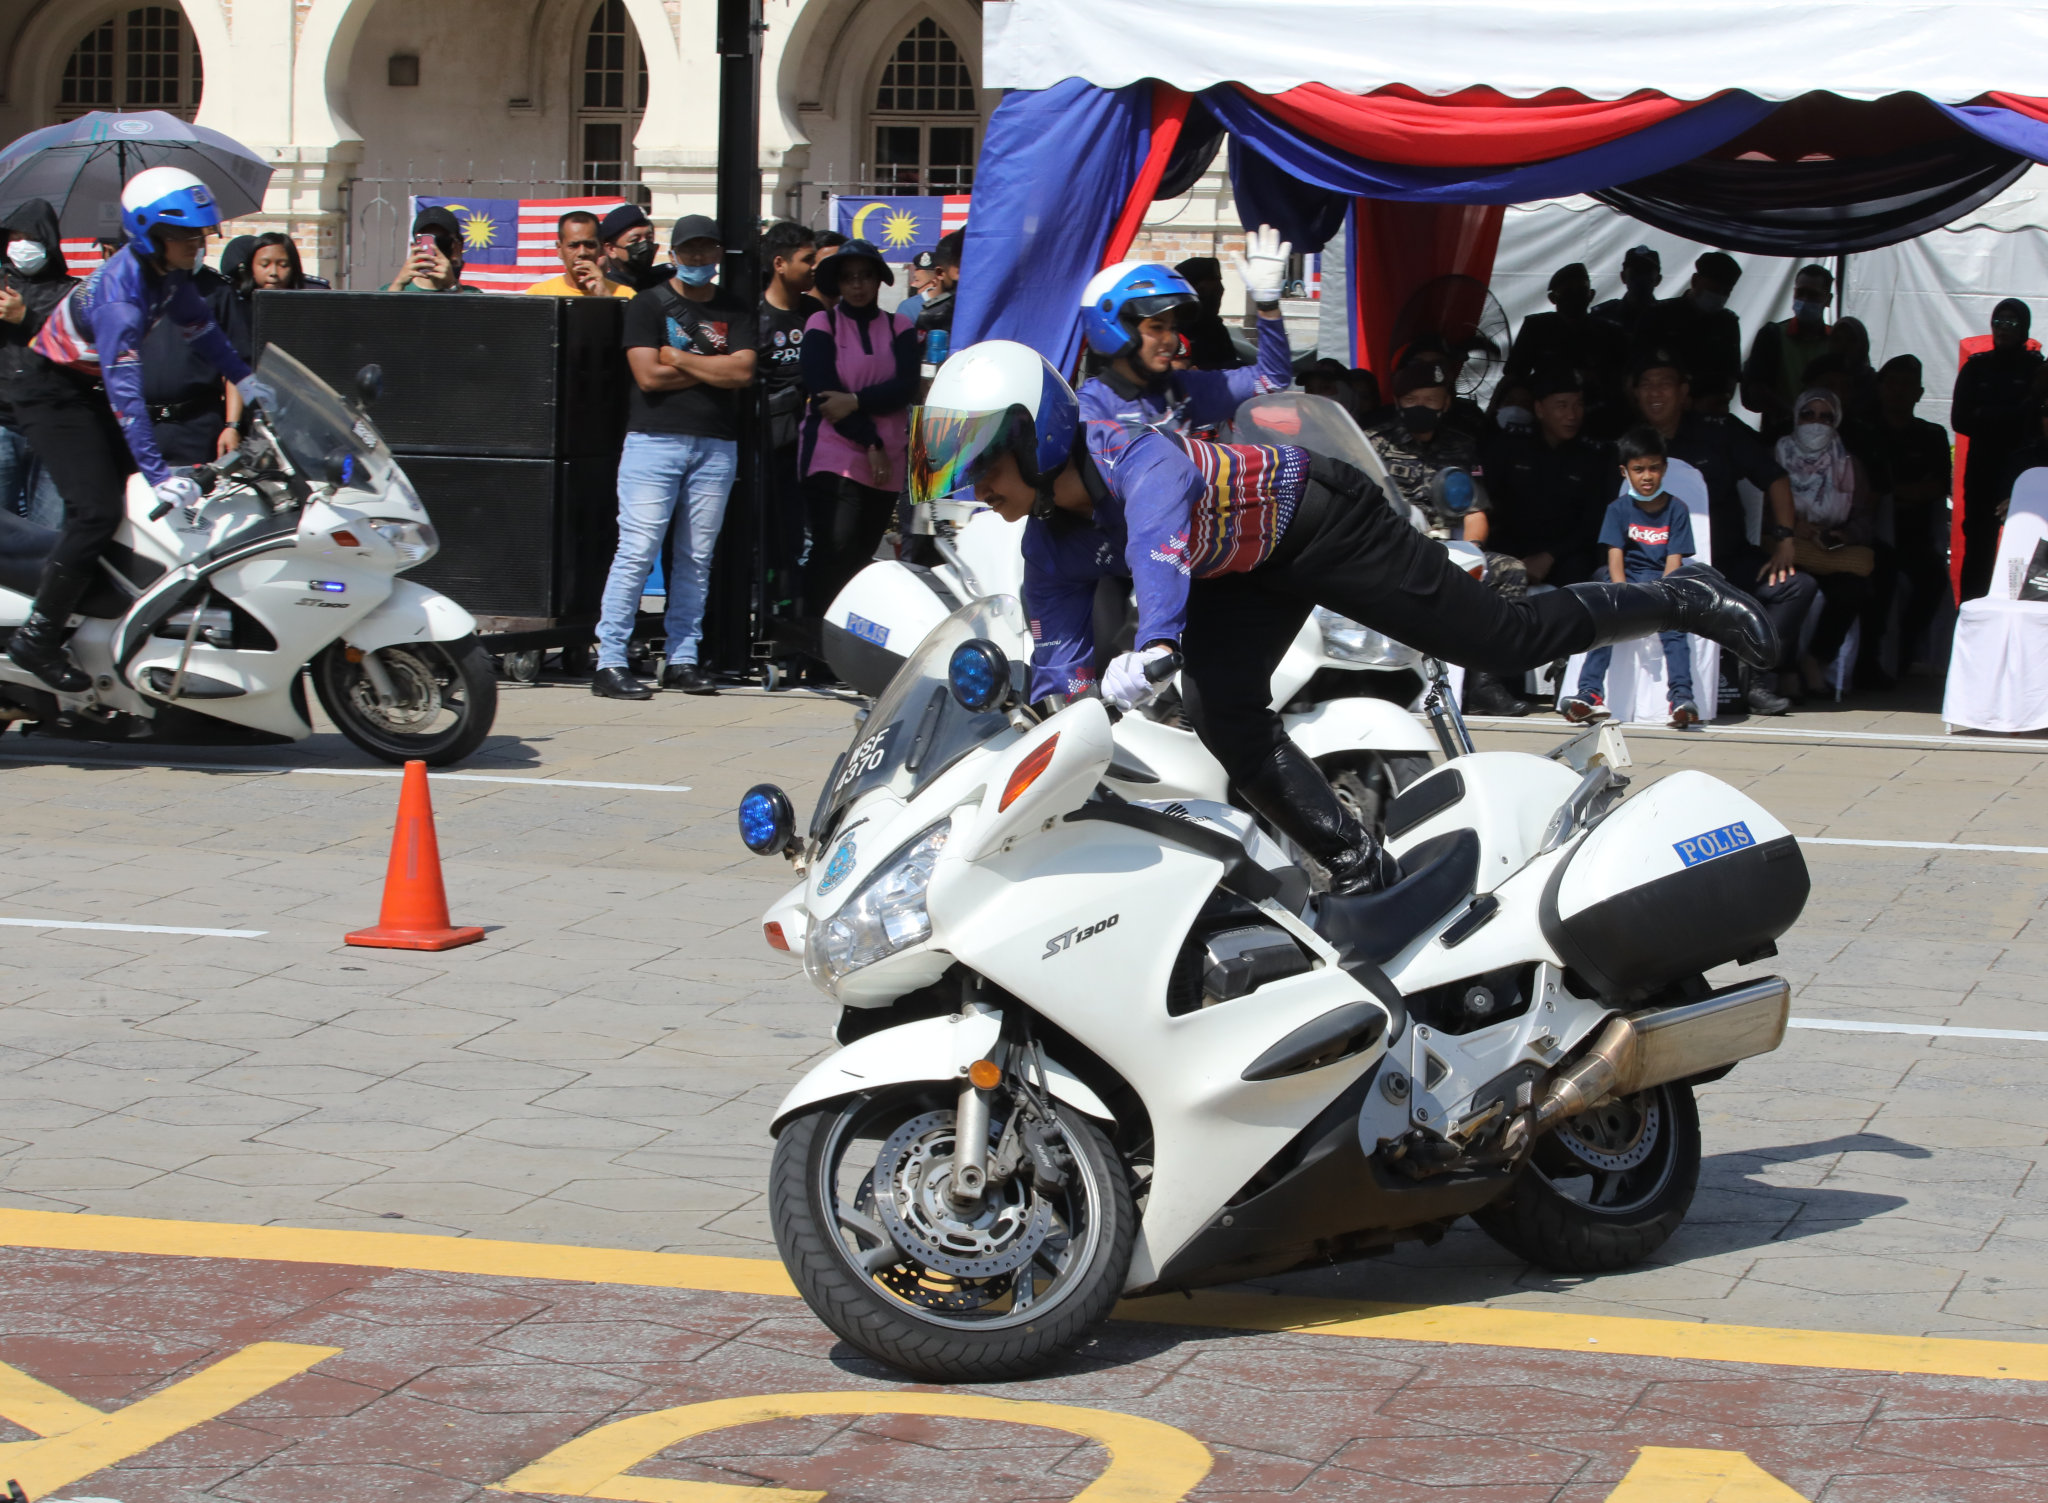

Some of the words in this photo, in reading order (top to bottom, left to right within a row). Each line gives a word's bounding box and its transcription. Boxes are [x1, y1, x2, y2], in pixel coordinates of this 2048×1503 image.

[847, 614, 887, 644] POLIS
[848, 727, 890, 767] WSF
[834, 748, 885, 794] 4370
[1680, 824, 1750, 863] POLIS
